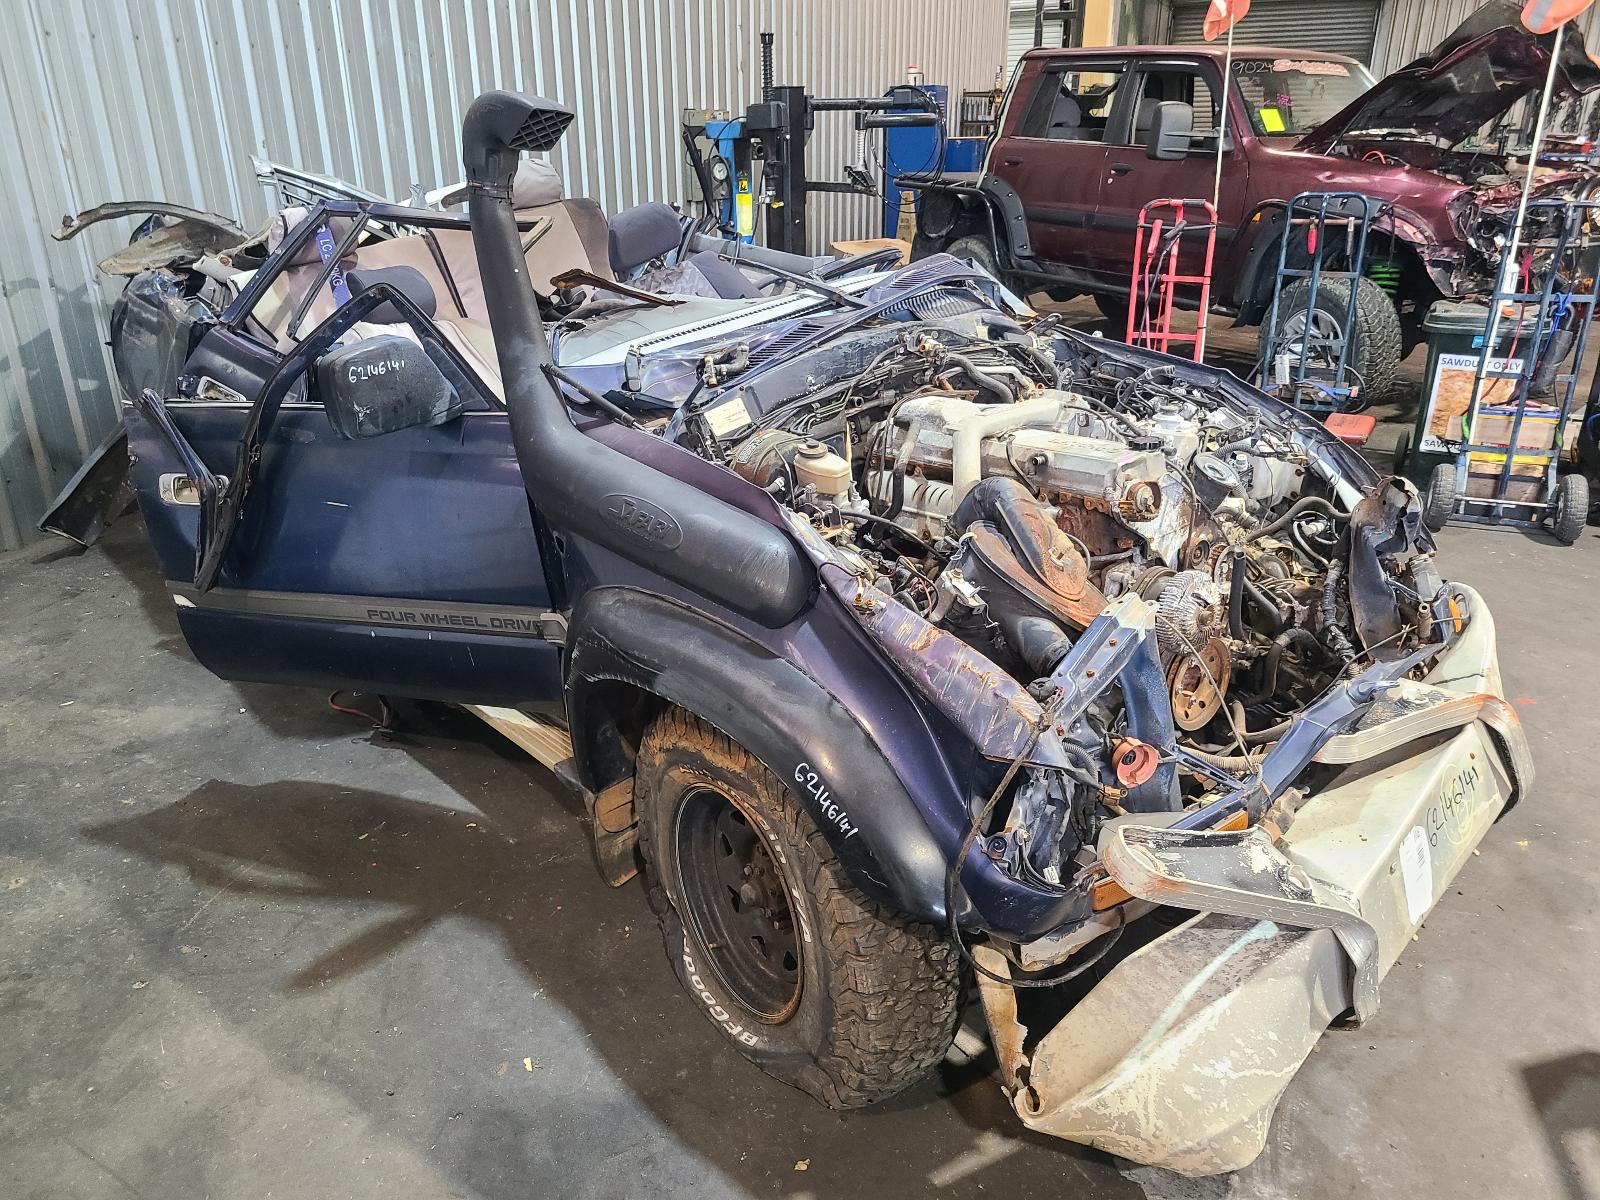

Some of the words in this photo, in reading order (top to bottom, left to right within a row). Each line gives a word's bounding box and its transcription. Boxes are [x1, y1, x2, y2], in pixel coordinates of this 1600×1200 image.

[1231, 61, 1273, 74] 9024
[348, 360, 405, 383] 62146141
[1441, 357, 1491, 369] SAWDUT
[366, 609, 417, 623] FOUR
[420, 612, 488, 628] WHEEL
[795, 762, 859, 839] 62146141
[1427, 766, 1480, 847] 62146141
